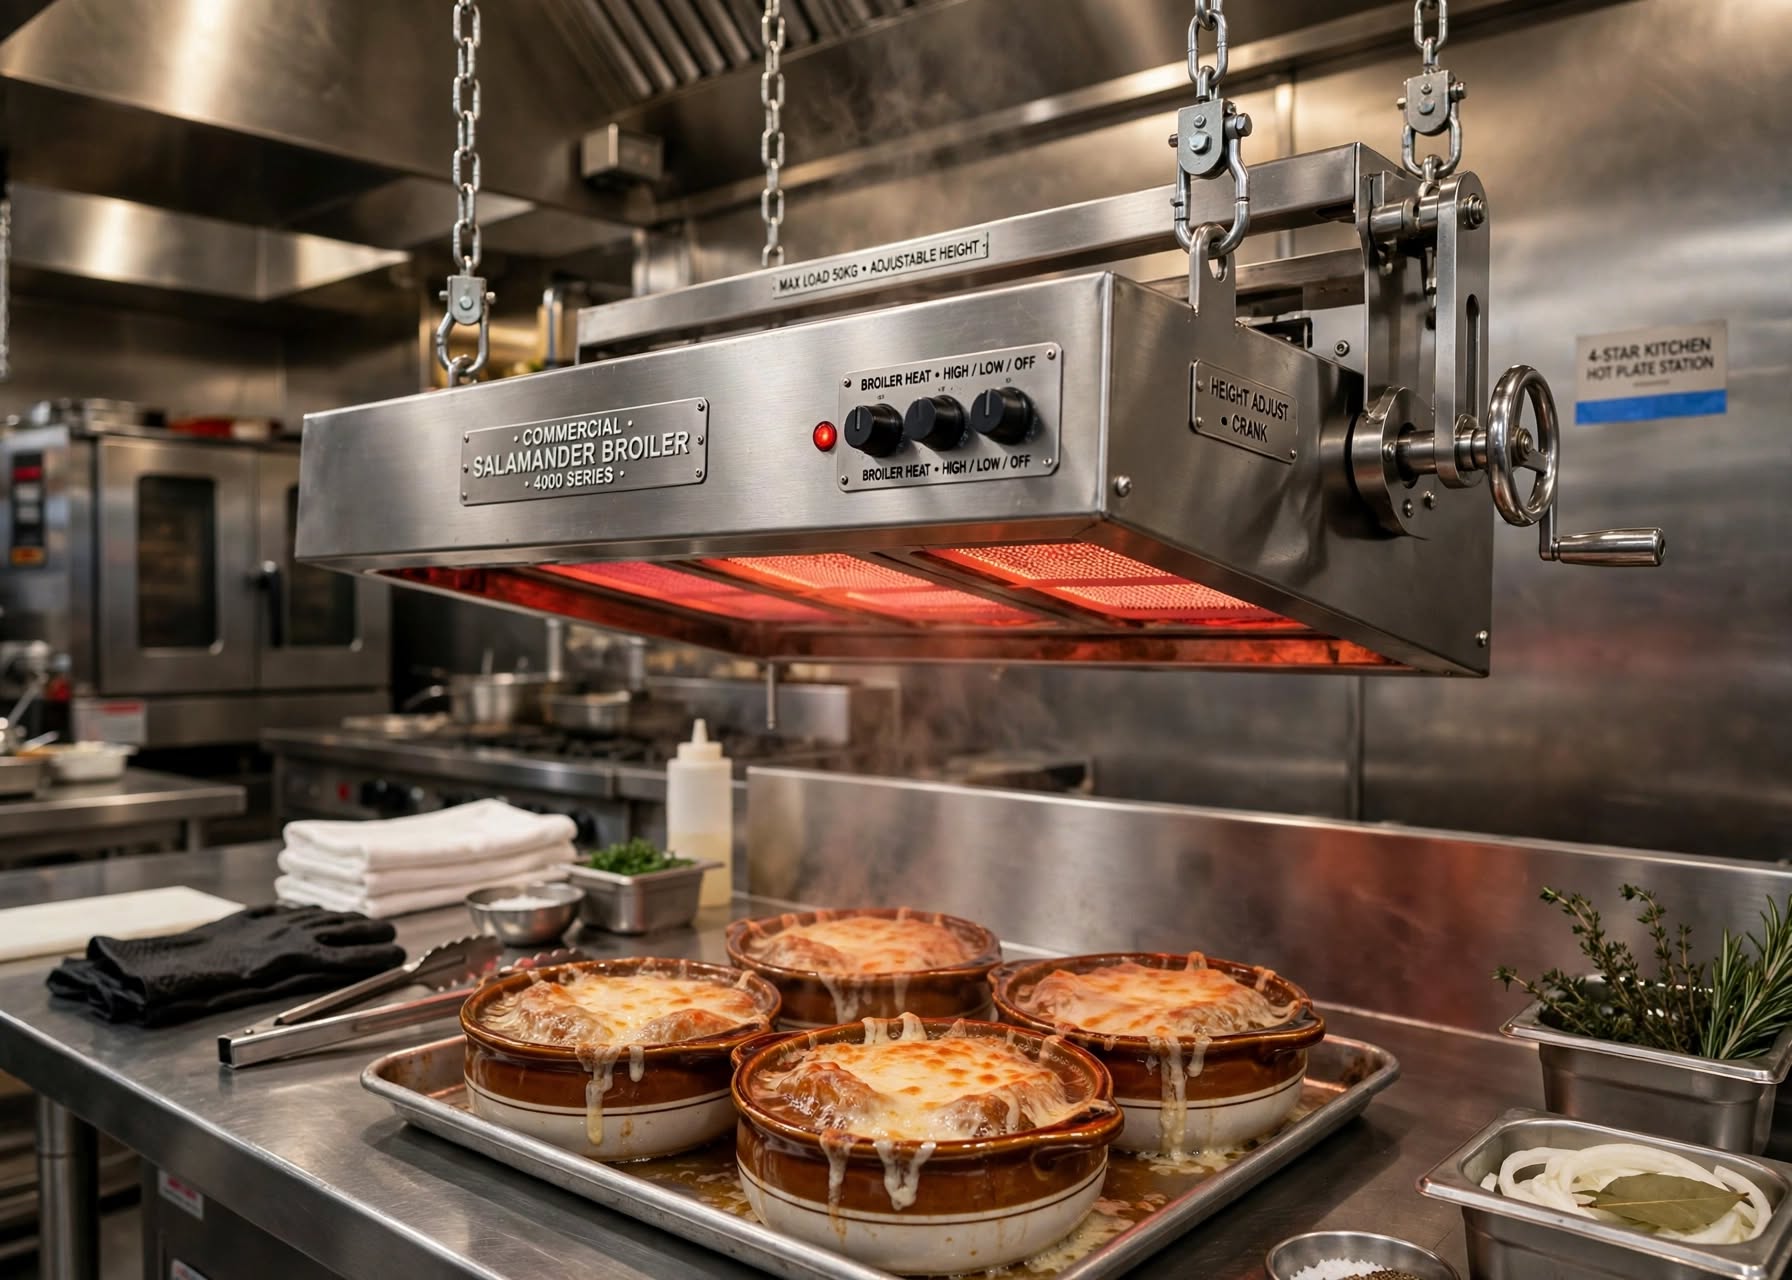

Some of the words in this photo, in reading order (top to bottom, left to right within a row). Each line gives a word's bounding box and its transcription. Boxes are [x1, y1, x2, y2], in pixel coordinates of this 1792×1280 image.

[779, 277, 800, 292] MAX
[802, 270, 829, 287] LOAD
[832, 264, 858, 281] 50KG
[870, 248, 936, 274] ADJUSTABLE
[939, 239, 980, 261] HEIGHT
[1588, 344, 1640, 362] 4-STAR
[1644, 337, 1712, 357] KITCHEN
[861, 373, 903, 391] BROILER
[905, 370, 932, 385] HEAT
[944, 364, 969, 380] HIGH
[979, 360, 1004, 376] LOW
[1014, 355, 1036, 371] OFF
[1586, 365, 1612, 381] HOT
[1616, 360, 1656, 379] PLATE
[1659, 355, 1714, 374] STATION
[1210, 376, 1250, 407] HEIGHT
[1251, 392, 1289, 421] ADJUST
[523, 417, 622, 446] COMMERCIAL
[1231, 414, 1268, 443] CRANK
[473, 442, 596, 478] SALAMANDER
[602, 431, 690, 463] BROILER
[862, 466, 903, 481] BROILER
[905, 463, 931, 478] HEAT
[942, 460, 968, 474] HIGH
[976, 457, 1001, 472] LOW
[1010, 455, 1031, 469] OFF
[533, 471, 563, 490] 4000
[566, 466, 614, 487] SERIES
